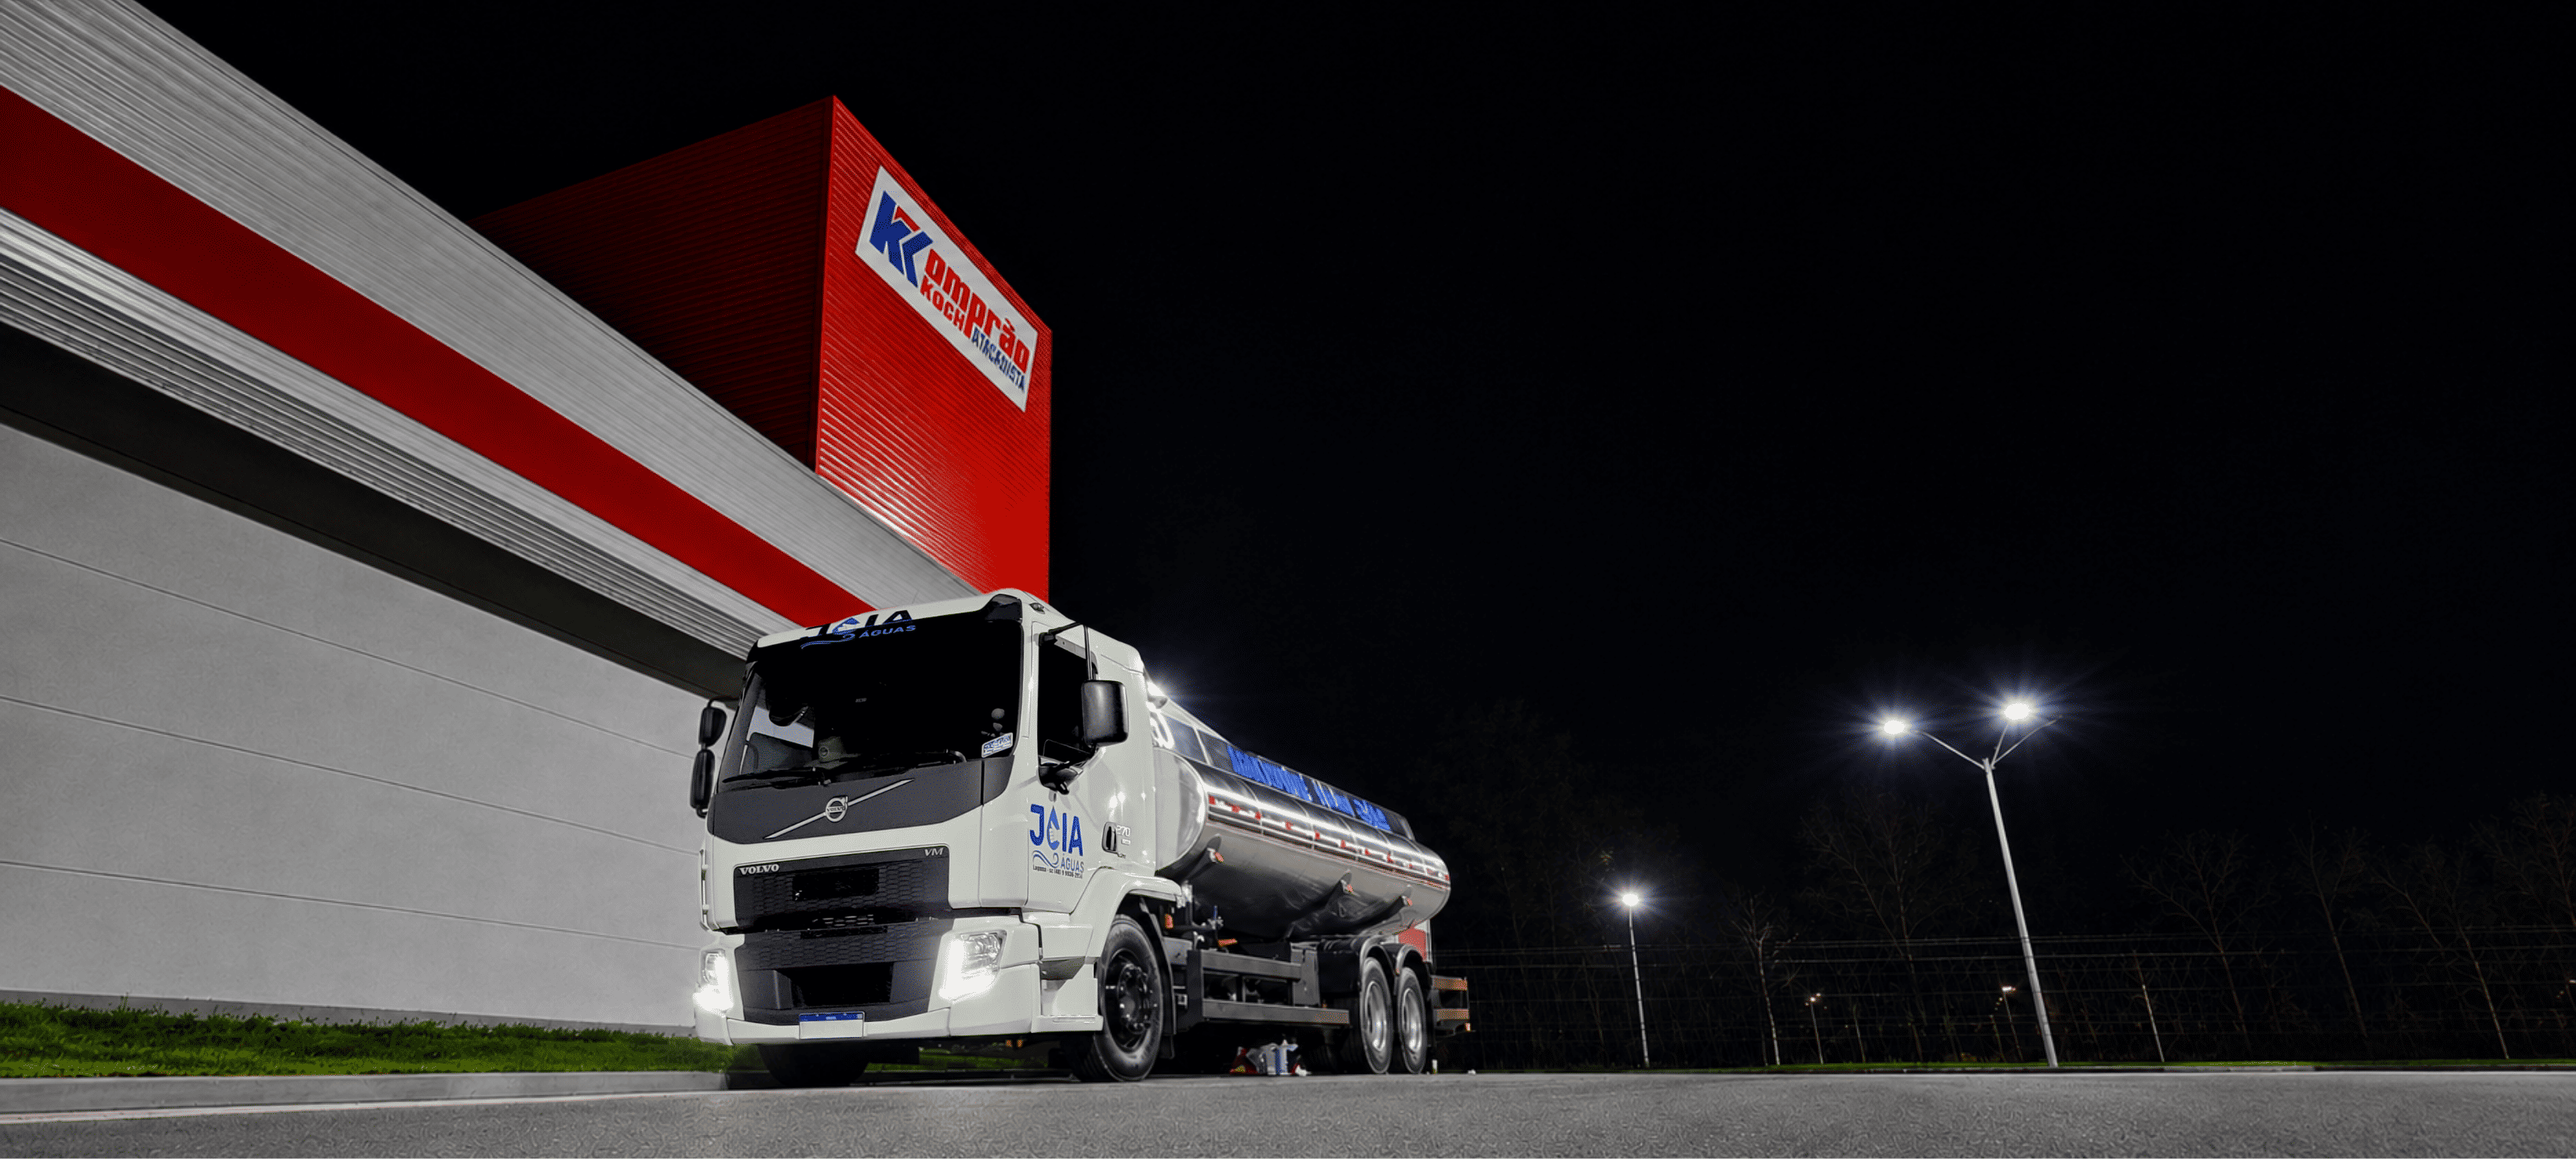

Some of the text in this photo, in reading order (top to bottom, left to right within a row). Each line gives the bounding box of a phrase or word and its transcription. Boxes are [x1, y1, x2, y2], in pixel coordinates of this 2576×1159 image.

[920, 274, 966, 334] KOCH
[971, 326, 1026, 391] ATACADISTA
[739, 864, 779, 875] VOLVO
[924, 847, 944, 857] VM
